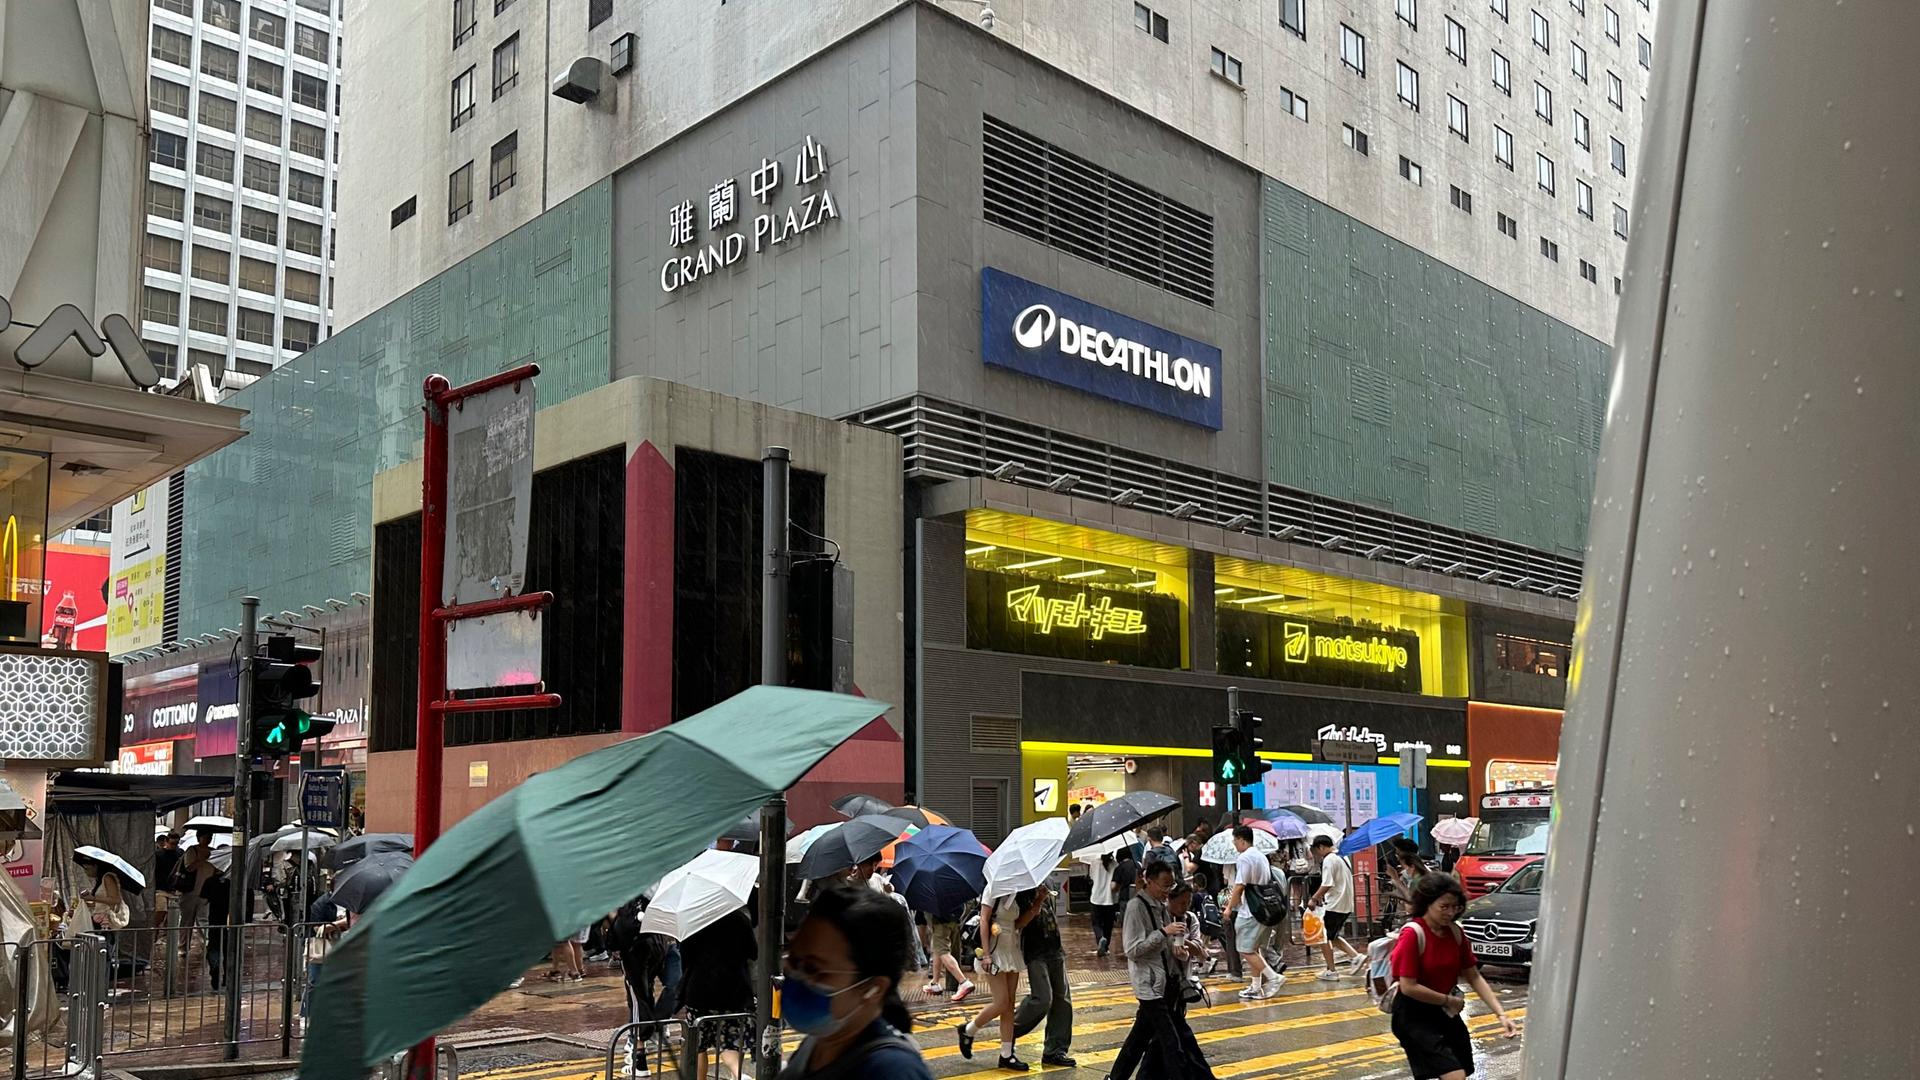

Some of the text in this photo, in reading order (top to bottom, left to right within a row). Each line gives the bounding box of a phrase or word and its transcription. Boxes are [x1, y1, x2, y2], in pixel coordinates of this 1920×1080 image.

[669, 134, 826, 248] 雅蘭中心
[661, 189, 838, 292] GRAND PLAZA
[1060, 317, 1211, 398] DECATHLON
[1315, 635, 1408, 673] matsukiyo
[153, 704, 188, 728] COTTON
[336, 708, 358, 724] PLAZA
[1485, 945, 1510, 955] 2268
